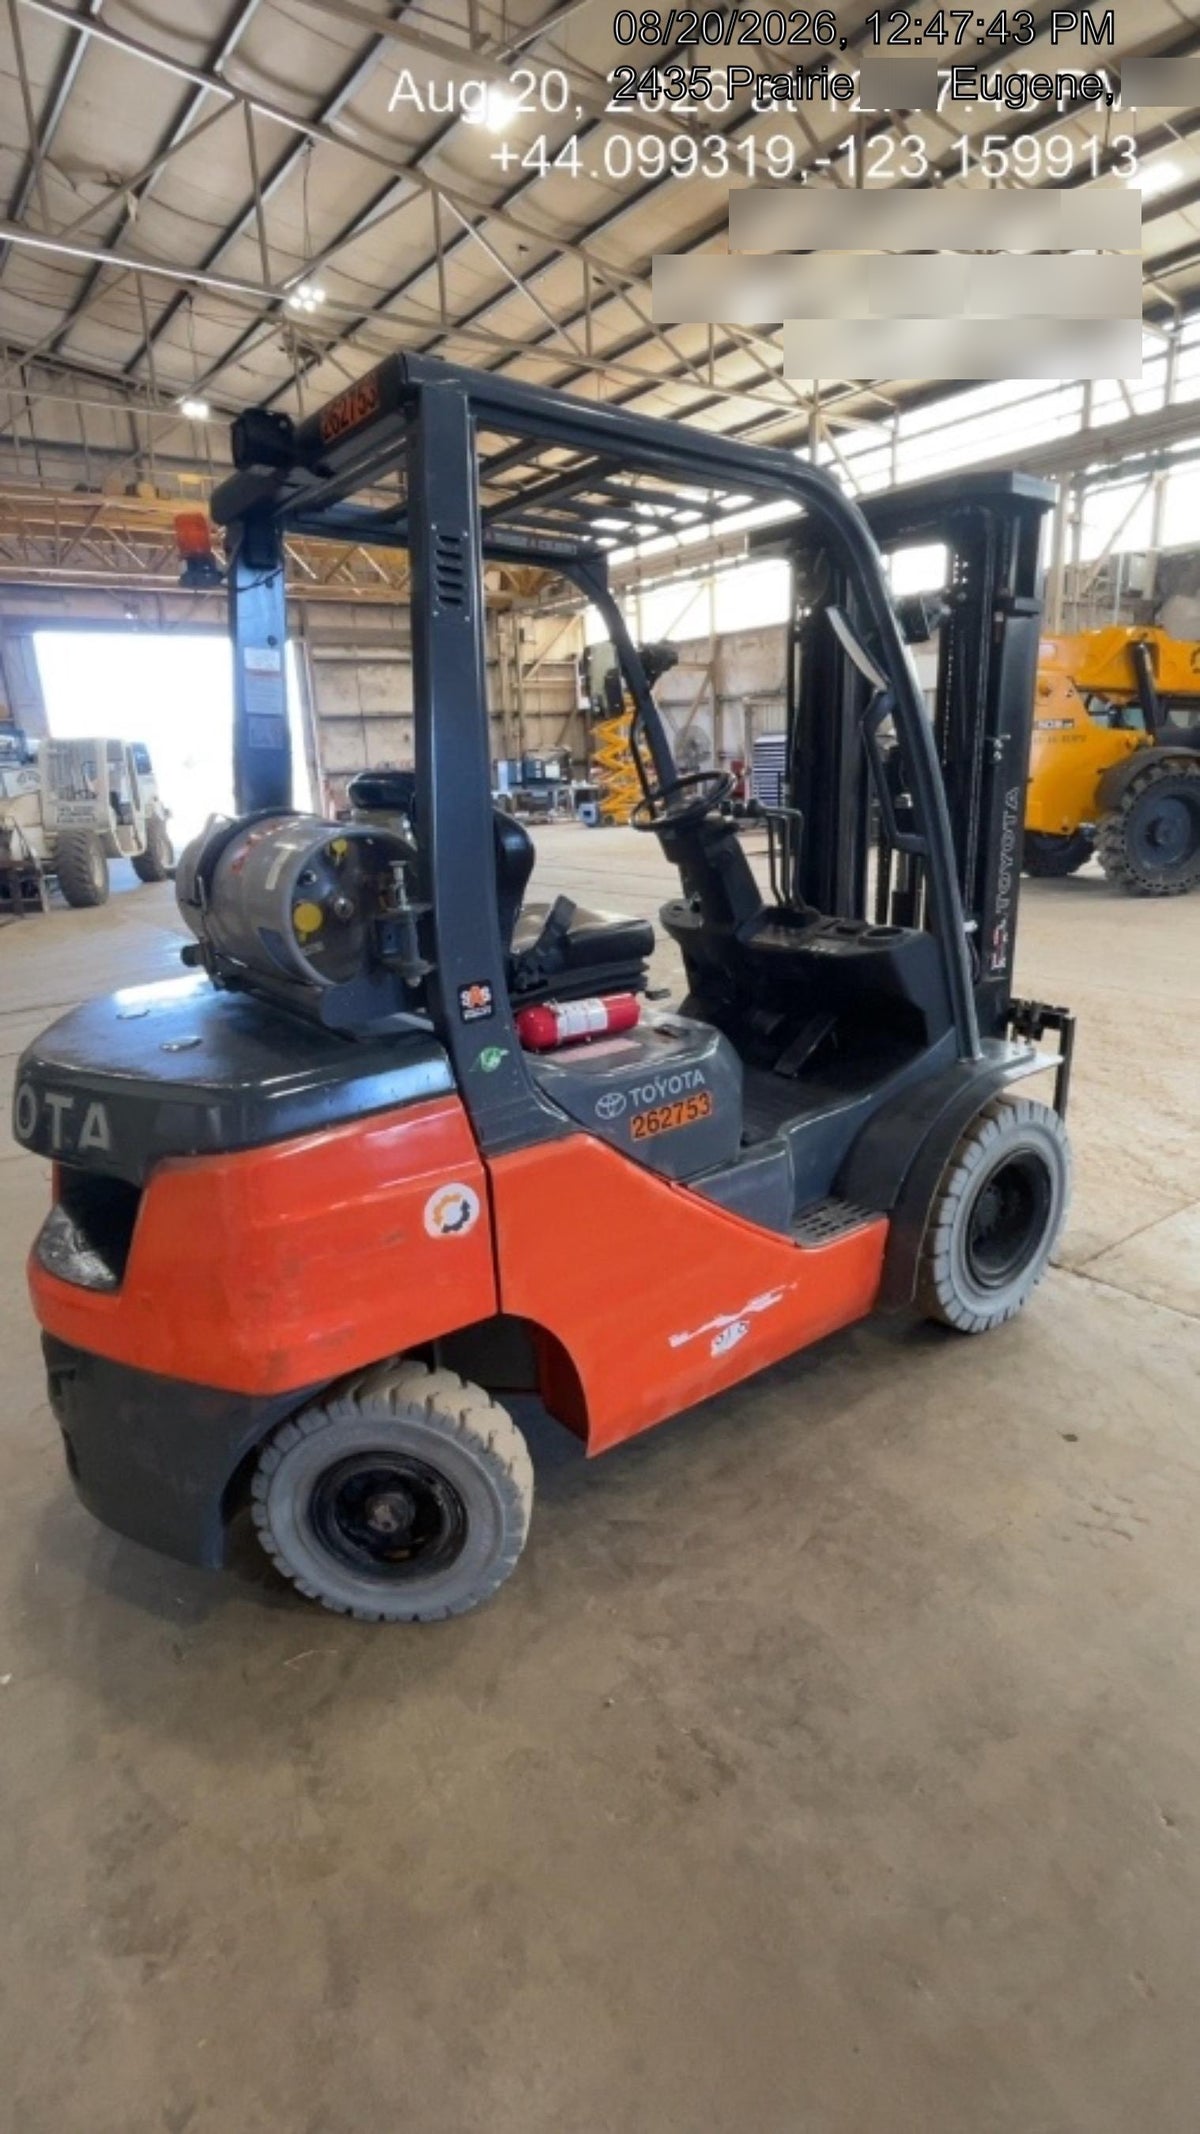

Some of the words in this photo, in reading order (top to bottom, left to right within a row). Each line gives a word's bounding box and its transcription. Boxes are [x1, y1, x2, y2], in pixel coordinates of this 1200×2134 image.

[996, 786, 1019, 914] TOYOTA
[628, 1069, 706, 1107] TOYOTA
[632, 1092, 710, 1138] 262753
